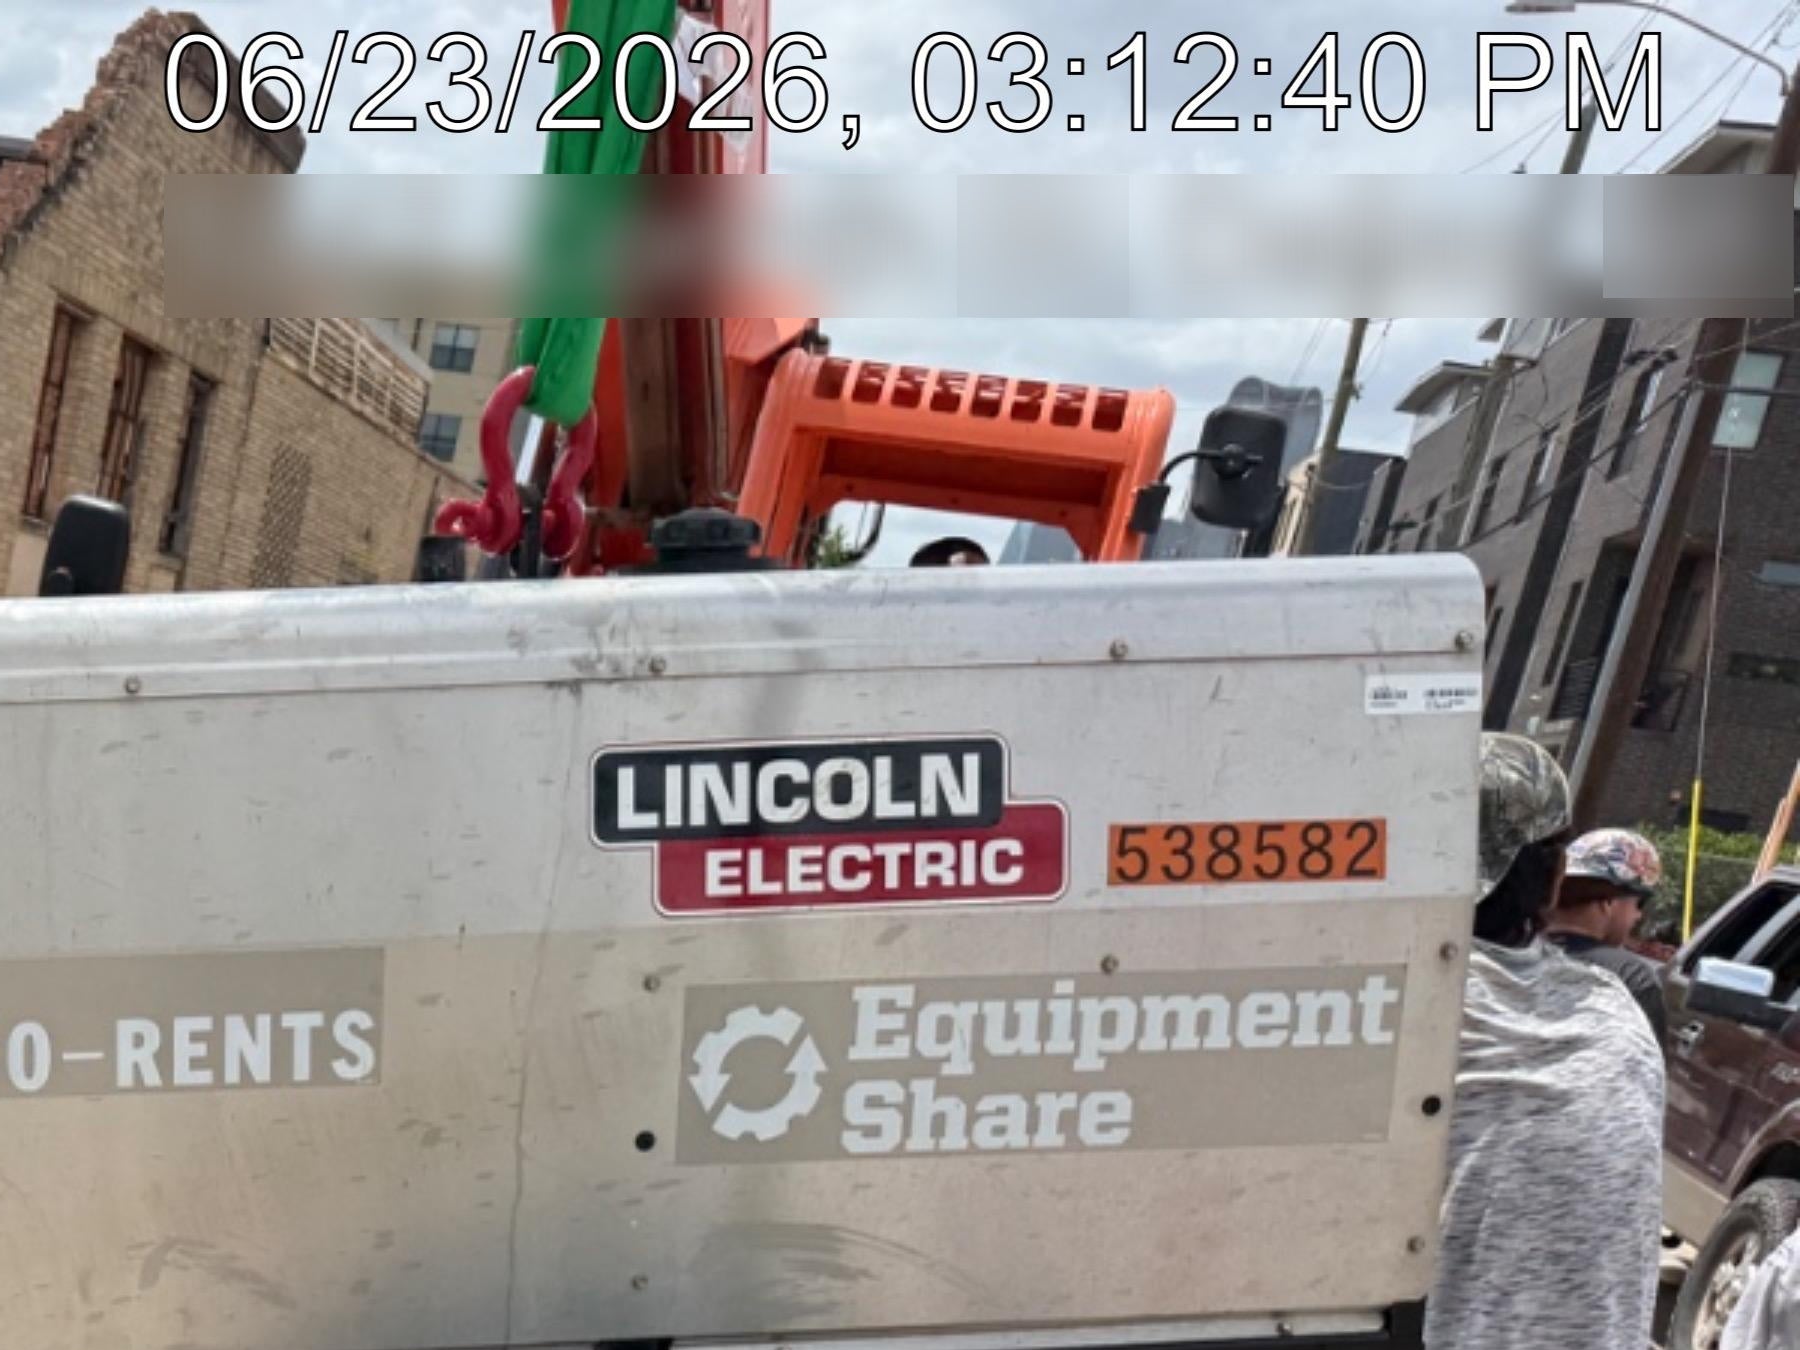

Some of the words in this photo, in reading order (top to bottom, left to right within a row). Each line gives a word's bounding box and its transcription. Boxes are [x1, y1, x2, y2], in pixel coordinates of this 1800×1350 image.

[616, 752, 981, 830] LINCOLN
[704, 838, 1025, 897] ELECTRIC
[1114, 819, 1381, 882] 538582
[848, 975, 1399, 1076] Equipment
[840, 1077, 1133, 1155] Share
